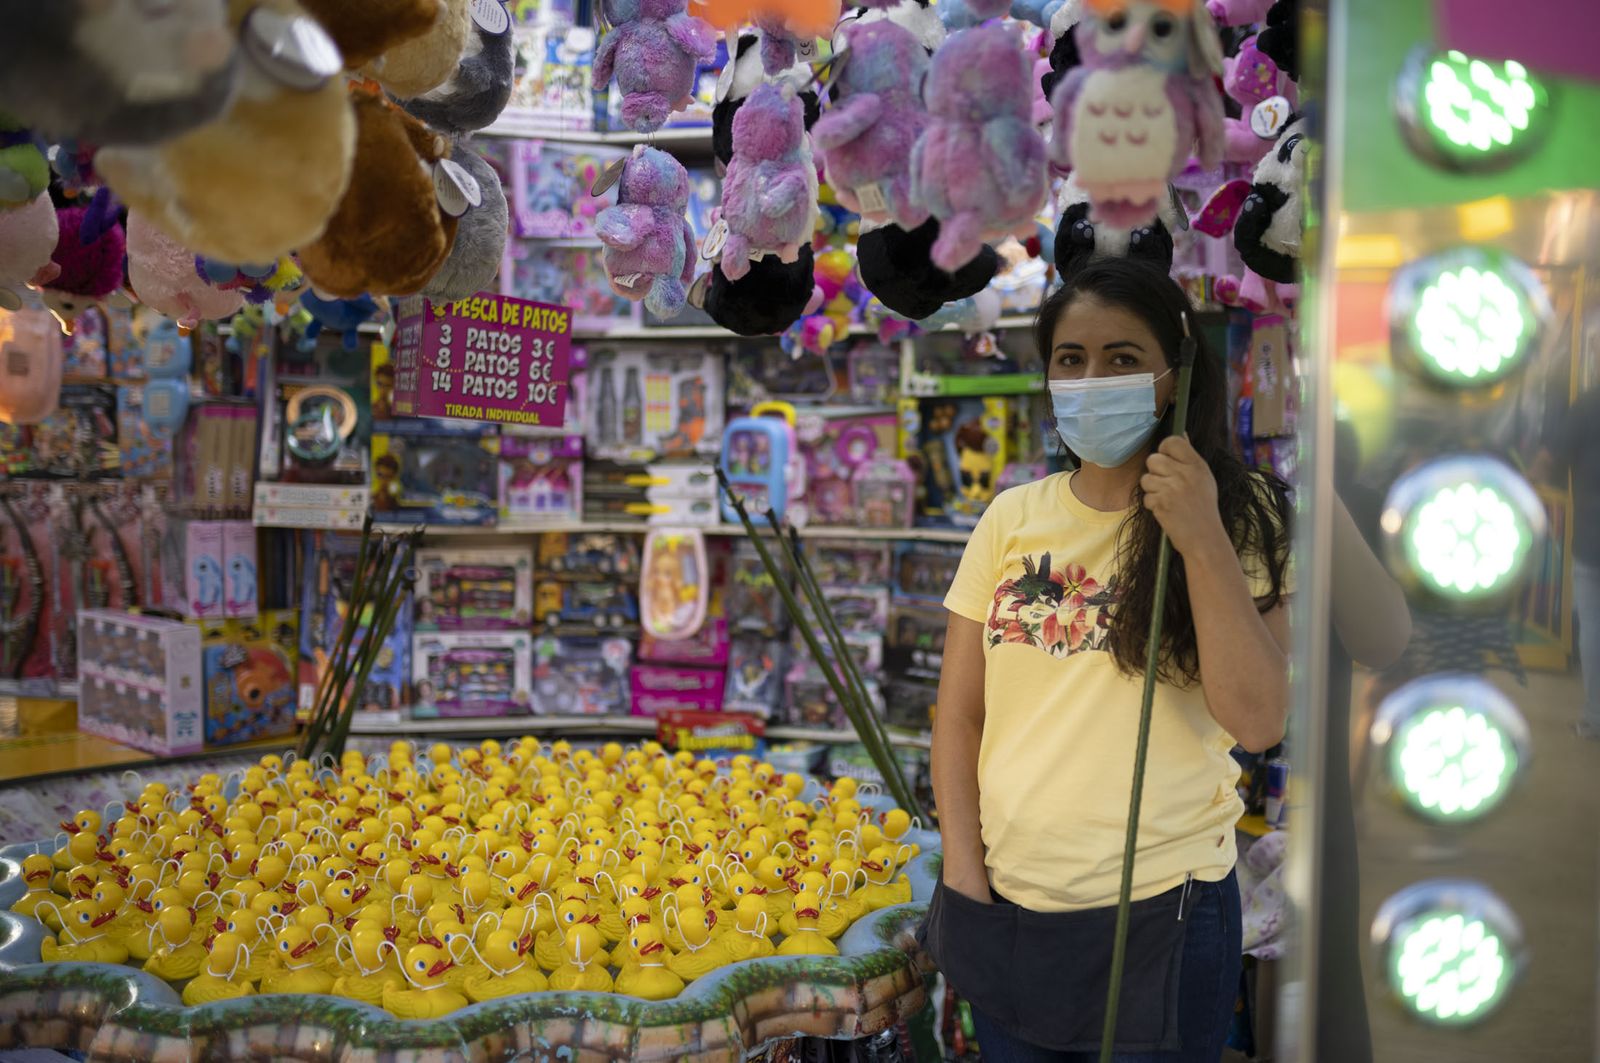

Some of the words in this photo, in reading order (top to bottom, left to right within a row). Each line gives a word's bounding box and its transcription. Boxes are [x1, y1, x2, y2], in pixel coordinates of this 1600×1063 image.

[452, 296, 499, 323] PESCA
[502, 304, 520, 326] DE
[523, 307, 568, 334] PATOS
[439, 324, 452, 345] 3
[466, 327, 522, 355] PATOS
[531, 338, 555, 360] 3€
[436, 347, 451, 369] 8
[464, 352, 520, 377] PATOS
[529, 362, 552, 382] 6€
[432, 371, 452, 393] 14
[462, 375, 519, 400] PATOS
[527, 383, 557, 405] 10€
[445, 403, 483, 419] TIRADA
[485, 408, 541, 425] INDIVIDUAL
